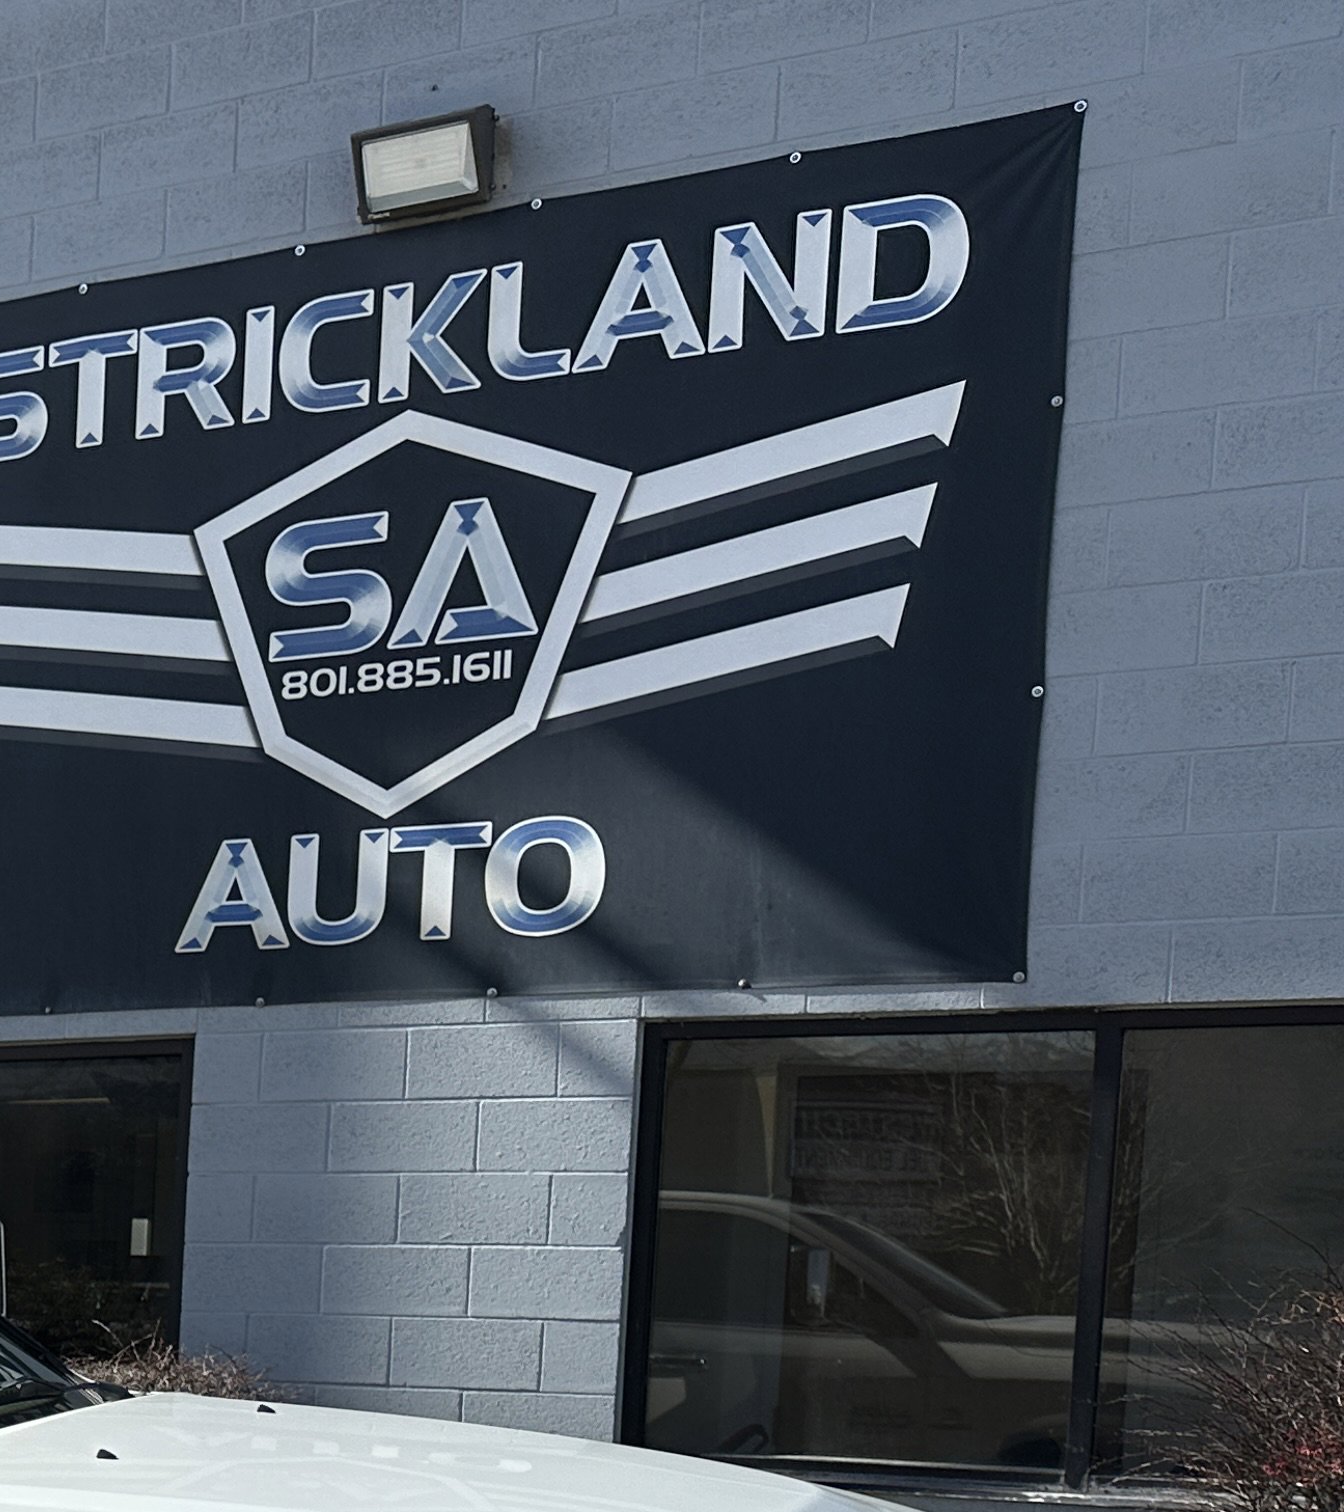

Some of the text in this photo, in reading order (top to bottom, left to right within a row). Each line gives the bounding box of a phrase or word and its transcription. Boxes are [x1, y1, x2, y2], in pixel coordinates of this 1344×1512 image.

[265, 498, 539, 662] SA
[281, 649, 512, 701] 801.885.1611
[173, 815, 606, 953] AUTO
